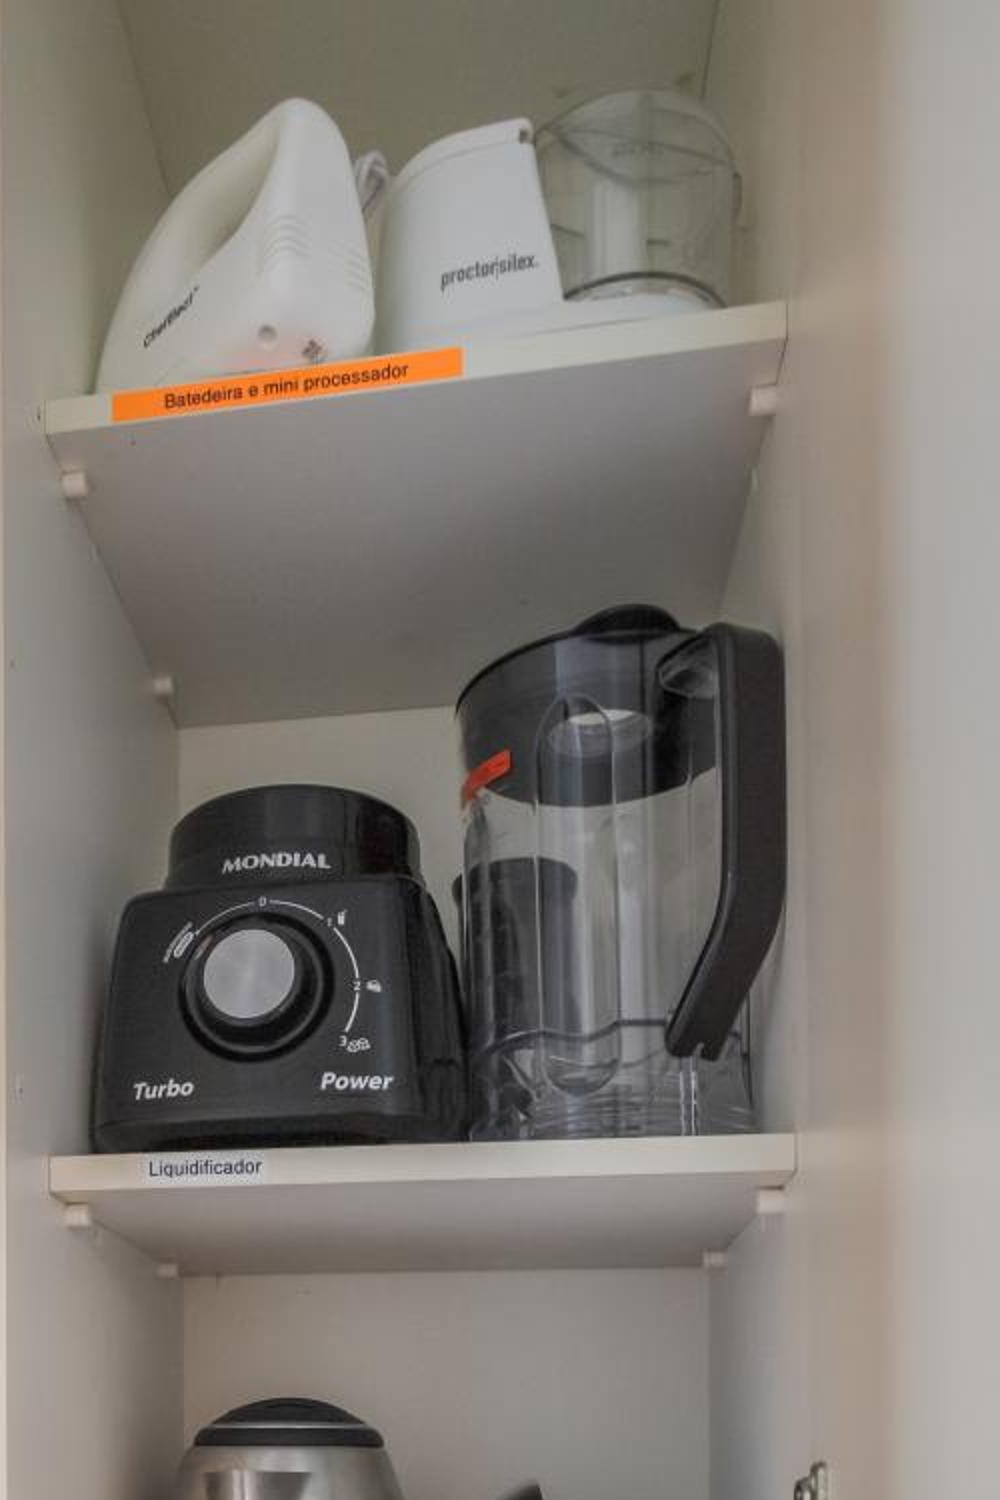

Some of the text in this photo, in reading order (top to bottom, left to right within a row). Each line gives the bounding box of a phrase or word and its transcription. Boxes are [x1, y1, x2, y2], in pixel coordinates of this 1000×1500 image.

[164, 363, 409, 410] Batedeira e mini processador
[221, 852, 332, 874] MONDIAL
[338, 1035, 347, 1047] 3
[133, 1078, 195, 1100] Turbo
[320, 1071, 395, 1091] Power
[149, 1159, 262, 1179] Liquidificador
